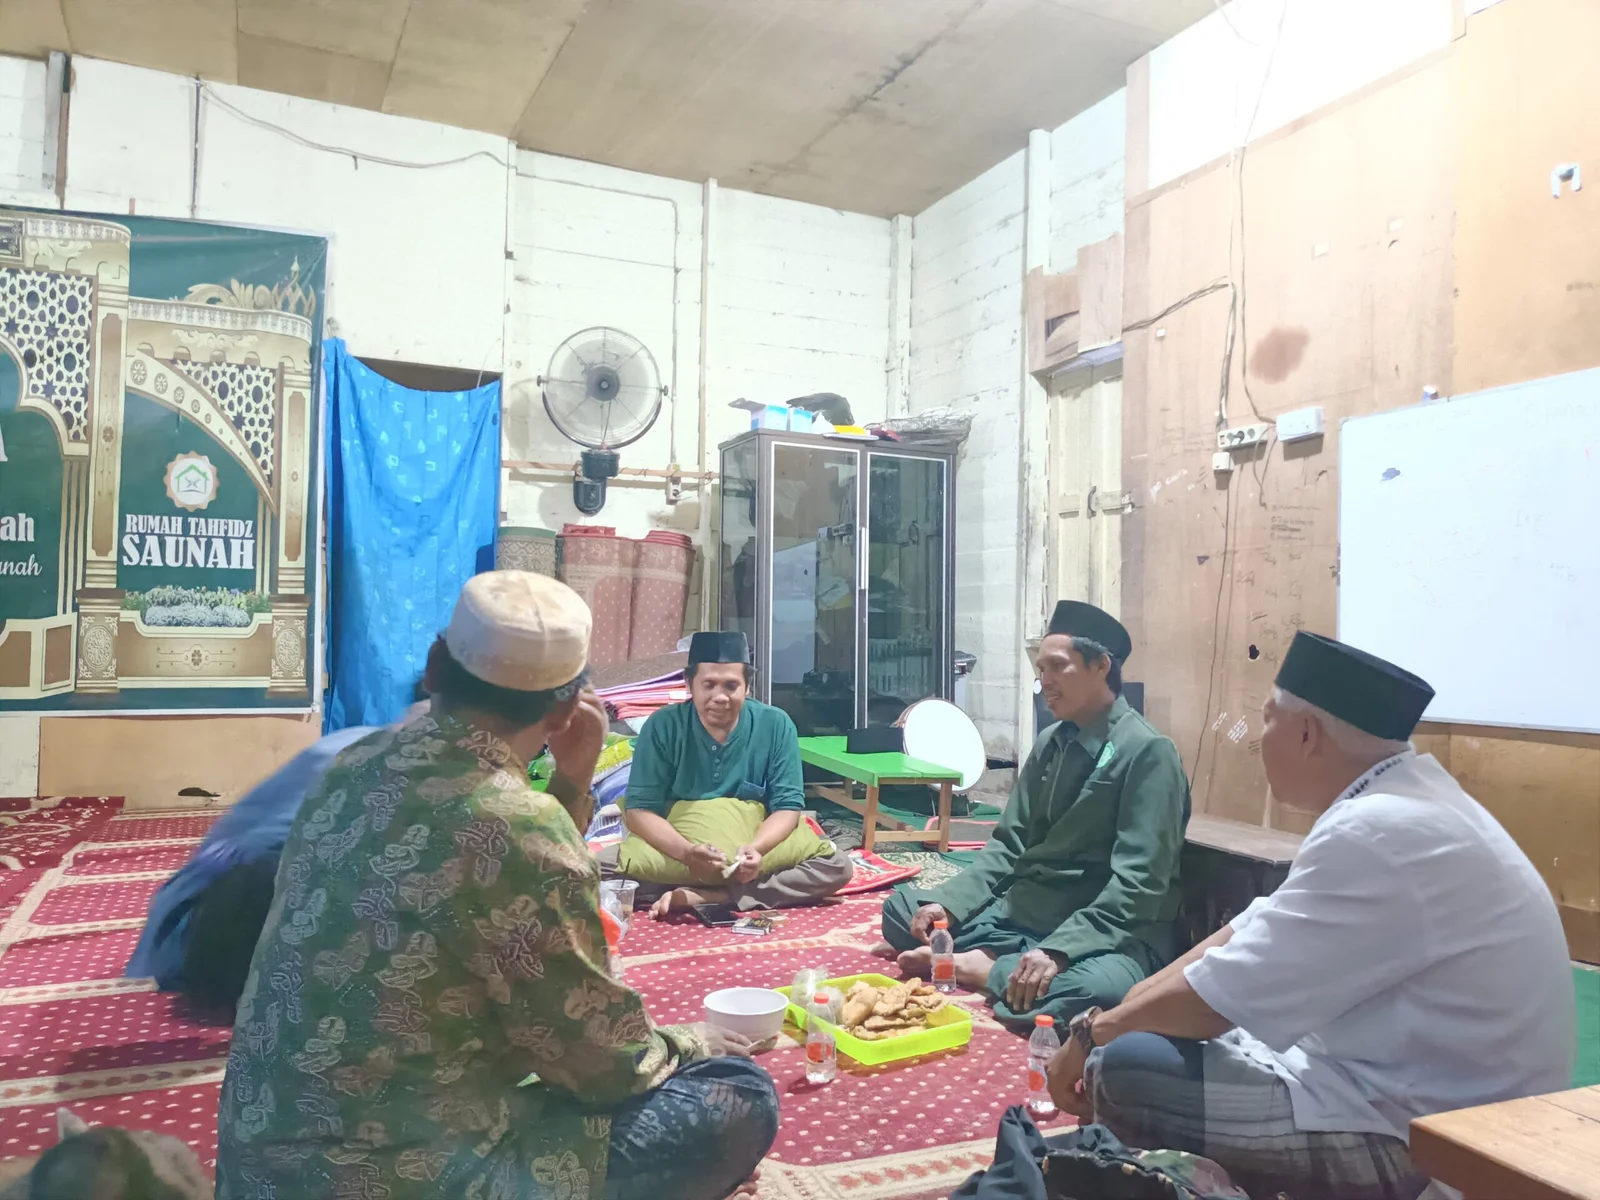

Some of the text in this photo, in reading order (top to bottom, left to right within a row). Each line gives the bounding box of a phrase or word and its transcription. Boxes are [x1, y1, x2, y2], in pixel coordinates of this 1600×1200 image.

[125, 514, 254, 538] RUMAH TAHFIDZ
[122, 534, 255, 570] SAUNAH
